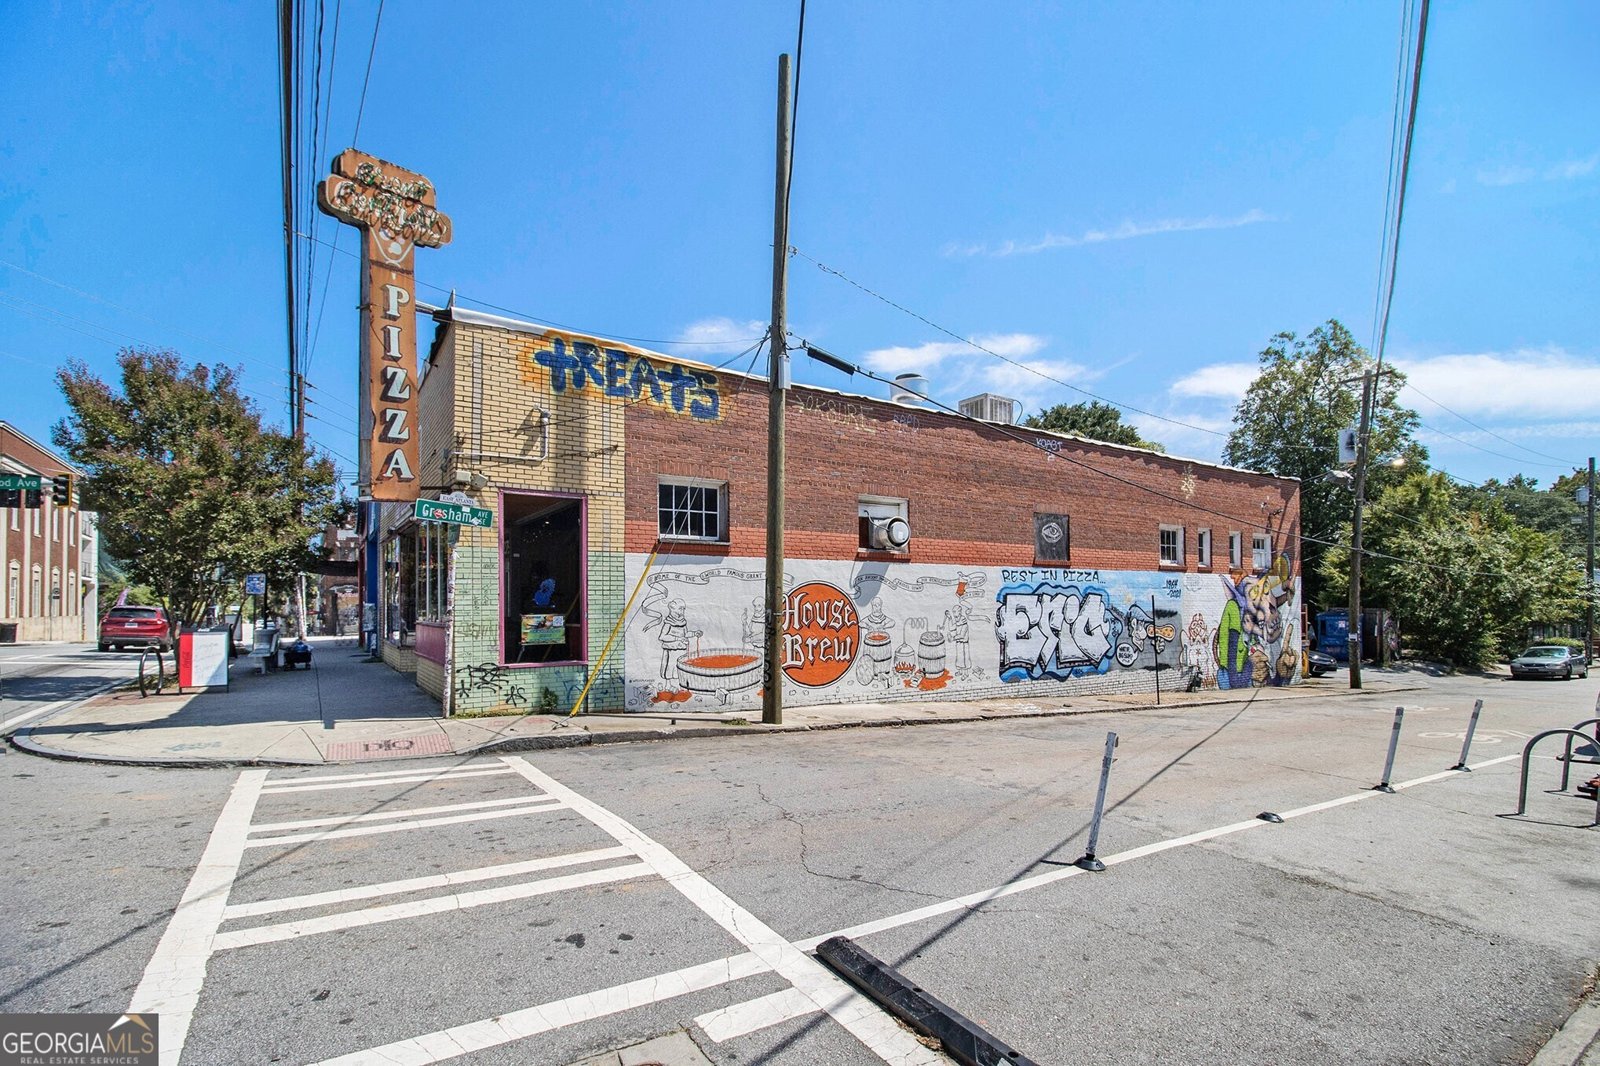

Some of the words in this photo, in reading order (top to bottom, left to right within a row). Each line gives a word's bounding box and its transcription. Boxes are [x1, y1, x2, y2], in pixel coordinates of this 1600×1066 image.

[377, 284, 414, 479] PIZZA
[17, 478, 38, 488] Ave
[422, 503, 472, 523] Grsham
[477, 510, 489, 518] AVE
[726, 569, 745, 579] FAMOUS
[1001, 569, 1037, 583] REST
[1041, 570, 1058, 581] IN
[782, 592, 858, 633] House
[996, 592, 1112, 671] ERIC
[781, 633, 853, 670] Brew
